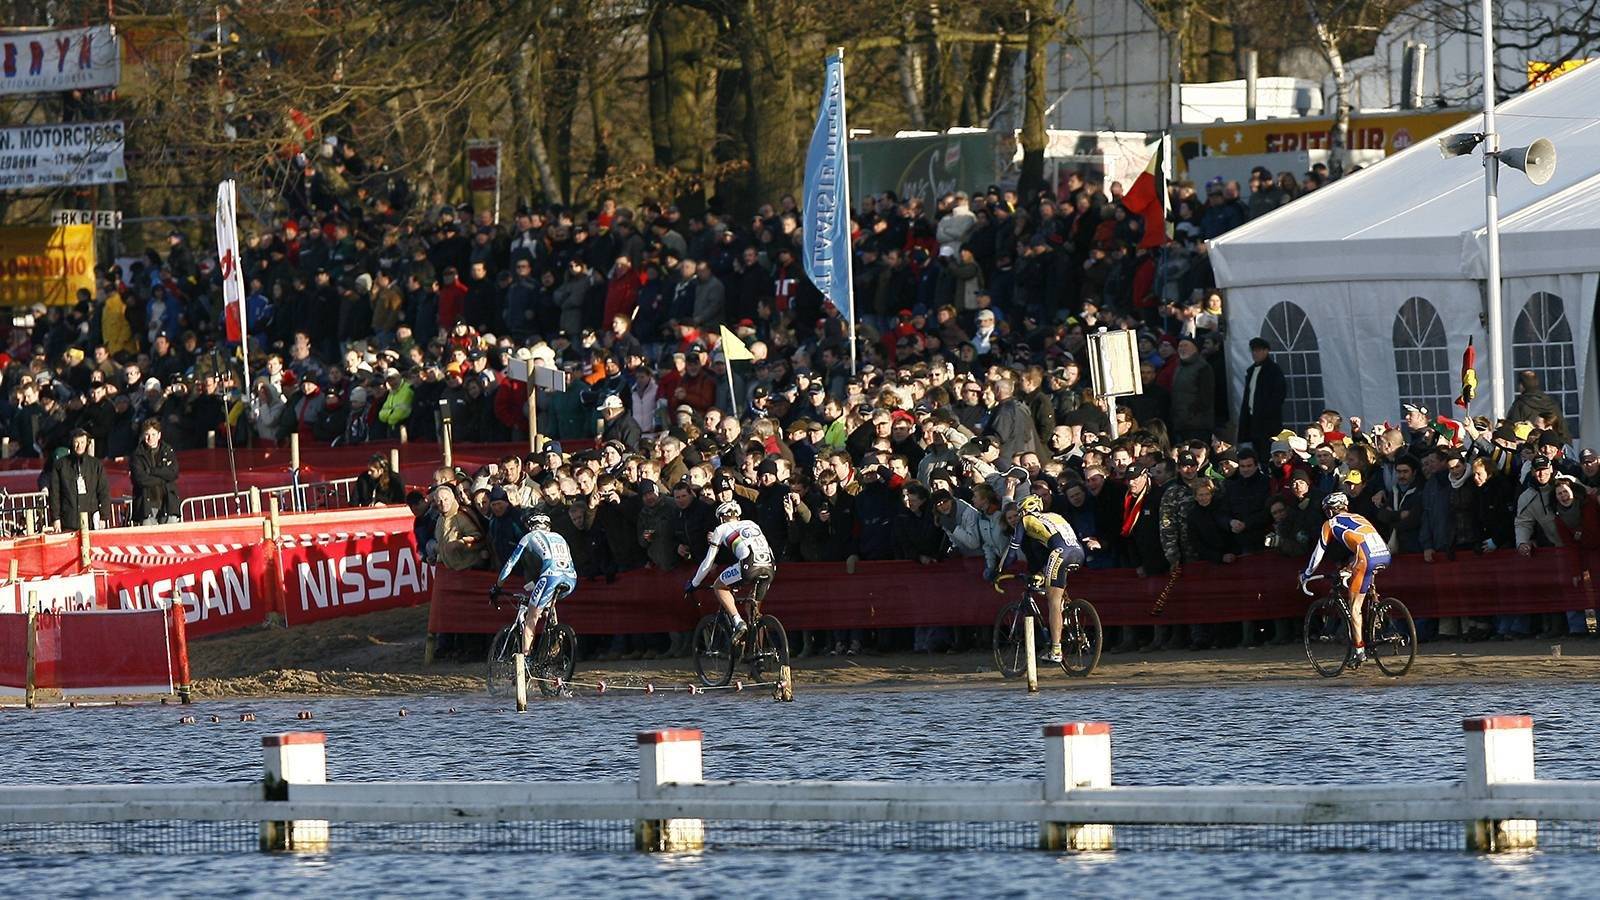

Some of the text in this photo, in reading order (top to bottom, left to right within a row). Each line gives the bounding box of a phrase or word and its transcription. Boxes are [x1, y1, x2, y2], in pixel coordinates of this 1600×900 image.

[19, 124, 122, 150] MOTORCROSS
[1265, 128, 1386, 153] FRITUR
[62, 211, 78, 224] BK
[721, 568, 740, 581] FIDEA
